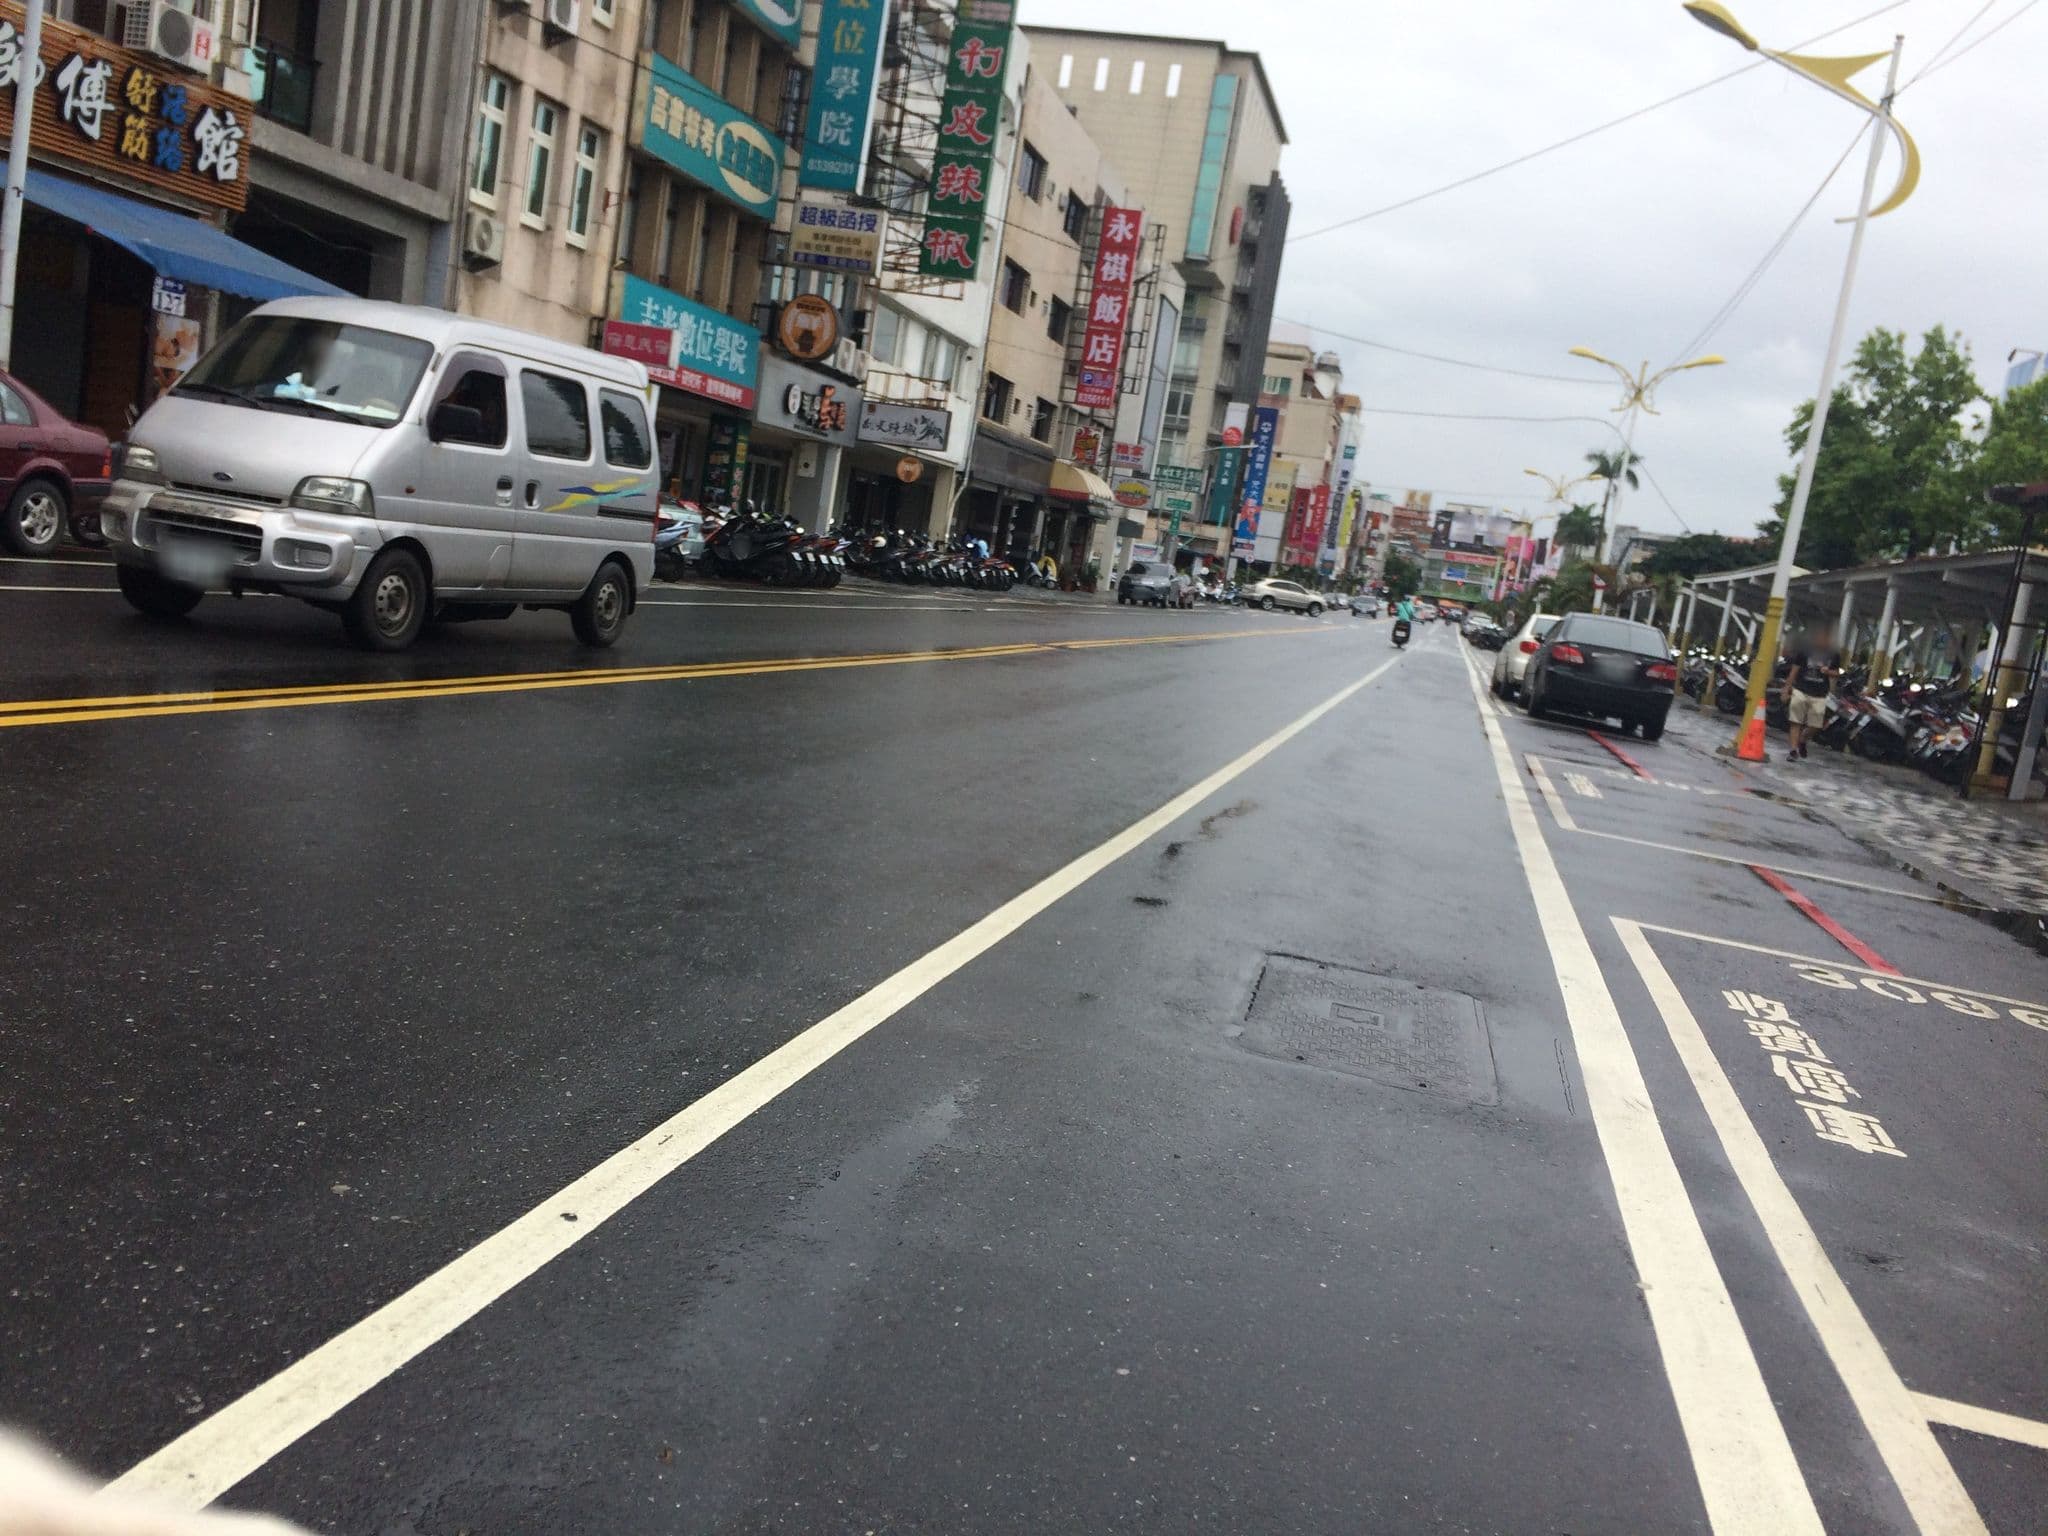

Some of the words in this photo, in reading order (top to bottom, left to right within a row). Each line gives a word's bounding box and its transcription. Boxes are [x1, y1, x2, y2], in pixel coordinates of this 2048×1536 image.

[818, 0, 870, 146] 位學院
[799, 206, 878, 233] 超級函授
[1086, 212, 1135, 367] 永祺飯店
[156, 291, 182, 313] 127
[1721, 989, 1908, 1158] 收費停車
